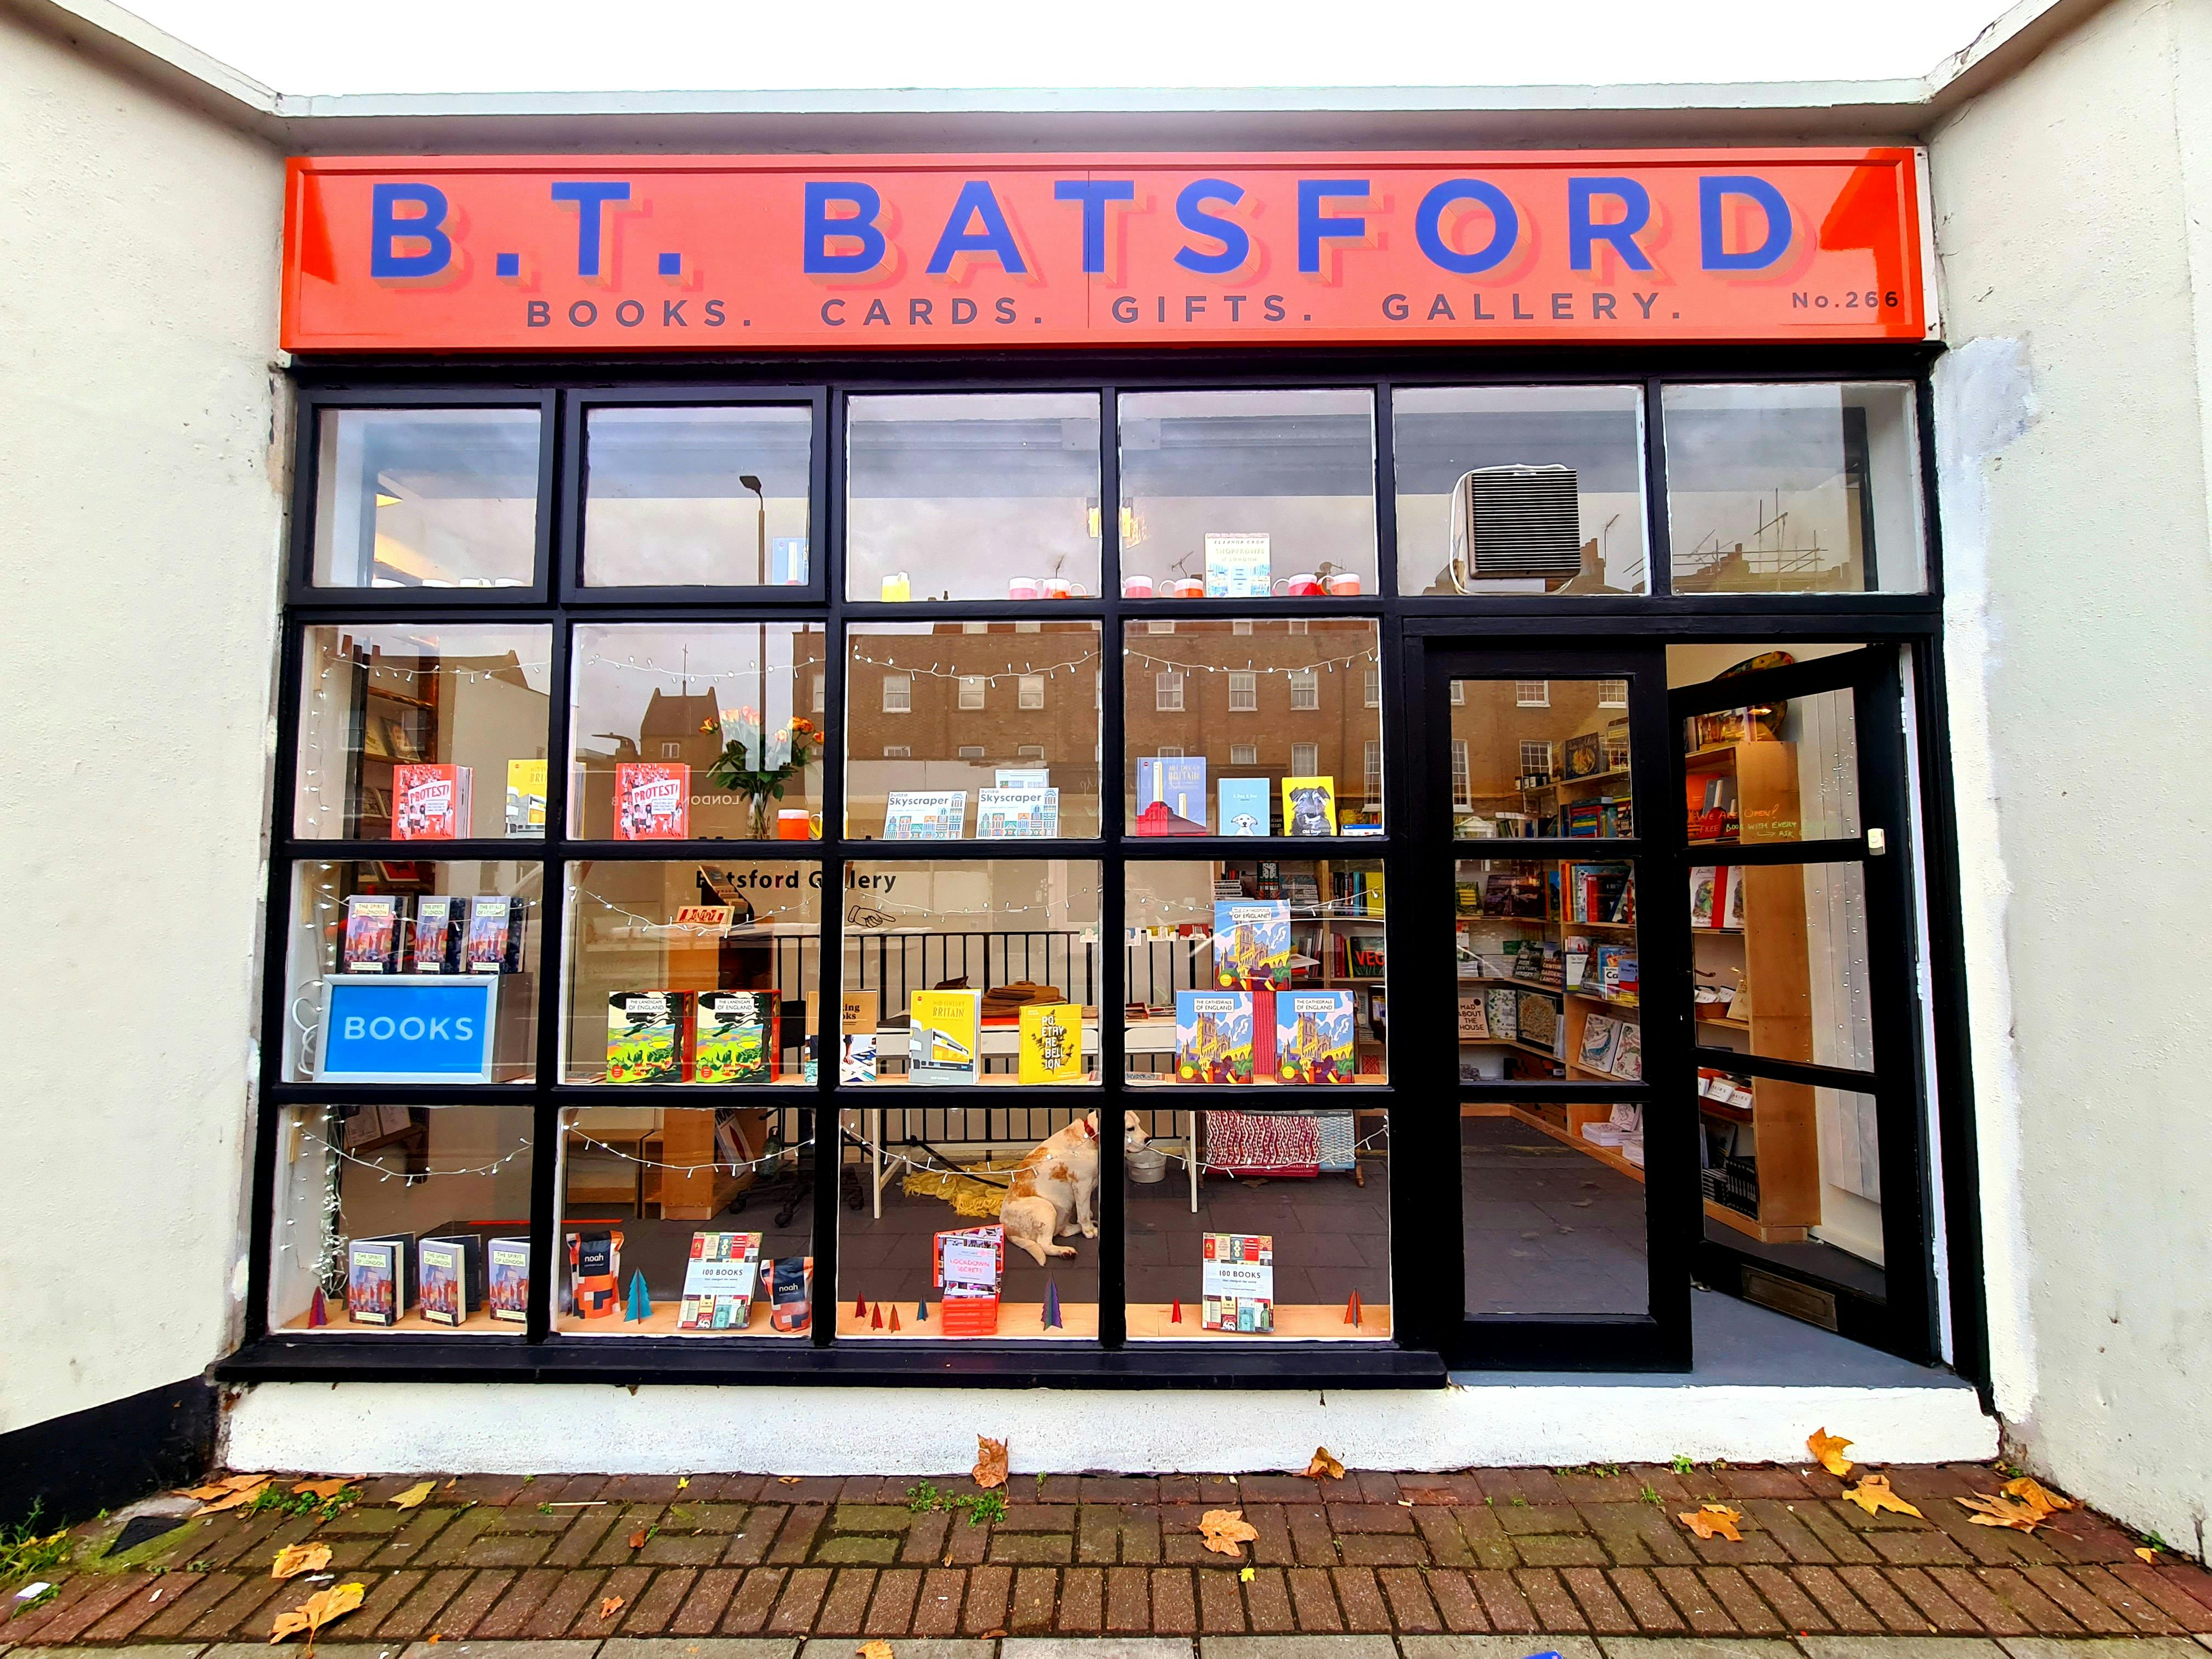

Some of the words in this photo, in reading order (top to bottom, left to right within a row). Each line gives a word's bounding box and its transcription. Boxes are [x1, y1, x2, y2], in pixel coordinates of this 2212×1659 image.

[371, 181, 680, 278] B.T.
[804, 177, 1793, 274] BATSFORD
[1792, 291, 1899, 308] No.266
[527, 299, 751, 328] BOOKS.
[821, 298, 1042, 326] CARDS.
[1111, 294, 1312, 324] GIFTS.
[1381, 293, 1680, 321] GALLERY.
[409, 784, 449, 804] PROTEST!
[634, 783, 678, 803] PROTEST!
[980, 793, 1042, 804] Skyscraper
[889, 797, 949, 807] Skyscraper
[1743, 804, 1780, 819] OPEN!
[809, 870, 896, 893] Glery
[933, 1007, 964, 1018] BRITAIN
[1042, 1016, 1054, 1025] PO
[344, 1016, 473, 1041] BOOKS
[1042, 1026, 1064, 1036] ETRY
[1045, 1037, 1057, 1047] RE
[1045, 1047, 1064, 1058] BELL
[1045, 1058, 1061, 1069] ION
[584, 1252, 603, 1262] noah
[950, 1259, 990, 1267] LOCKDOWN
[779, 1283, 798, 1292] noah
